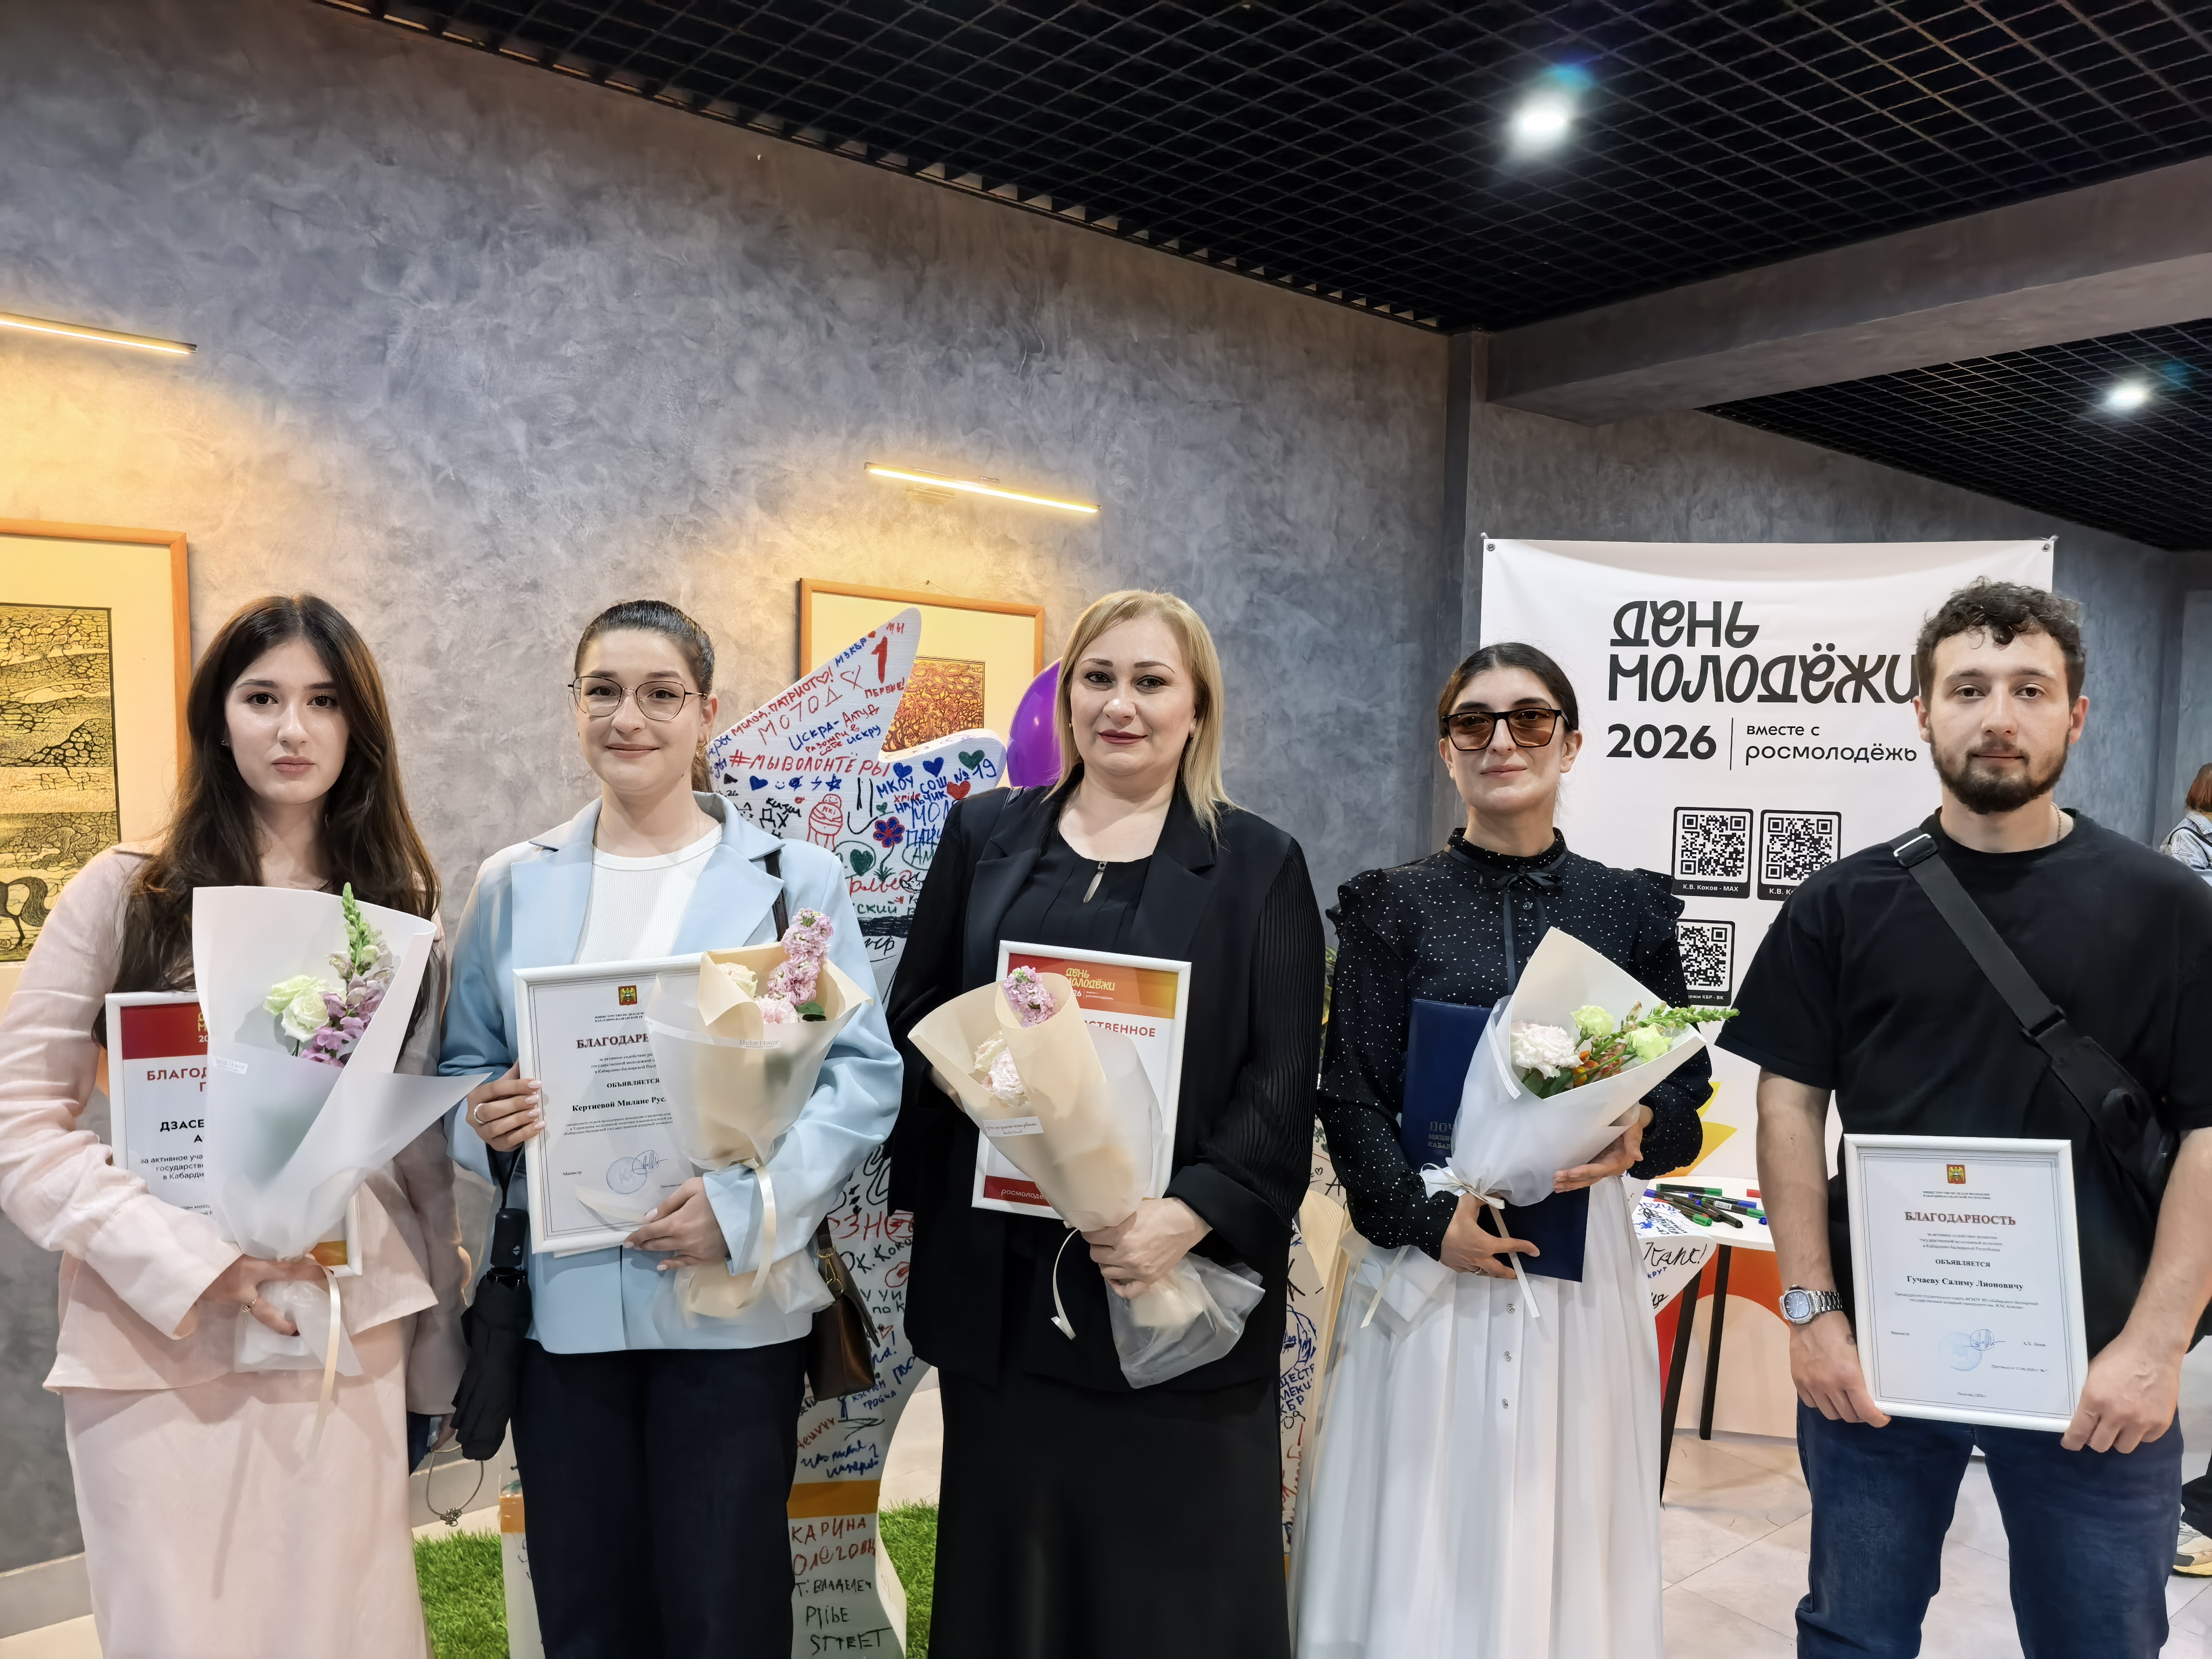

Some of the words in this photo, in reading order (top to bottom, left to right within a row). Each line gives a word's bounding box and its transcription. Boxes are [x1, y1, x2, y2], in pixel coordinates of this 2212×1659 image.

[871, 636, 888, 684] 1
[1746, 724, 1805, 736] вместе
[1811, 725, 1820, 737] с
[1606, 724, 1717, 759] 2026
[1745, 744, 1917, 766] росмолодёжь
[876, 776, 913, 798] МКОУ
[973, 758, 996, 779] 19
[606, 1078, 660, 1088] ОБЪЯВЛЯЕТСЯ
[572, 1101, 615, 1112] Кертиевой
[617, 1098, 649, 1107] Милане
[160, 1119, 204, 1132] ДЗАСЕ
[1001, 1189, 1047, 1200] росмолодё
[1904, 1211, 2017, 1225] БЛАГОДАРНОСТЬ
[1935, 1259, 1991, 1267] ОБЪЯВЛЯЕТСЯ
[1907, 1276, 1939, 1285] Гучаеву
[1941, 1278, 1974, 1287] Салиму
[1975, 1280, 2024, 1291] Лионовичу
[792, 1517, 866, 1545] КАРИНА
